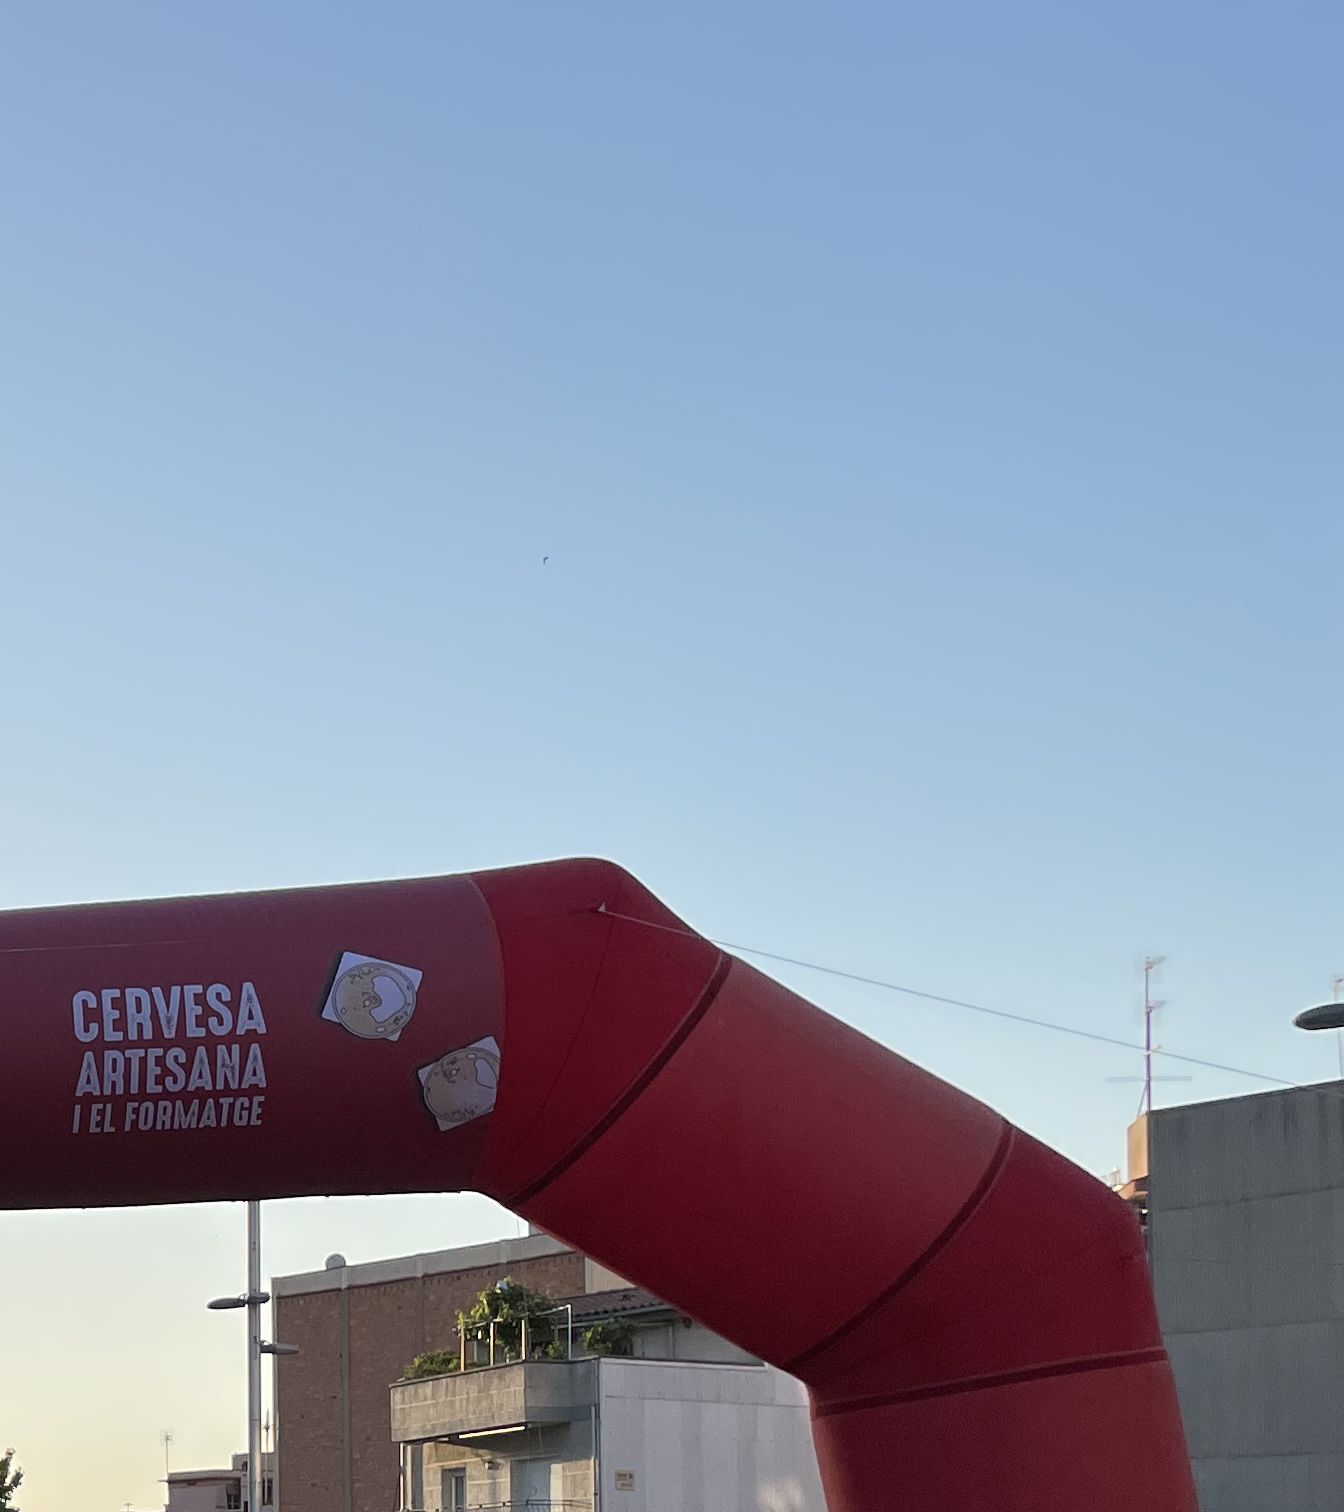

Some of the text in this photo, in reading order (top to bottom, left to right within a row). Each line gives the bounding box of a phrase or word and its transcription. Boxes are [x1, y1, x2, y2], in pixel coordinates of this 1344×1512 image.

[72, 981, 267, 1043] CERVESA
[75, 1043, 267, 1097] ARTESANA
[71, 1095, 266, 1134] I EL FORMATGE
